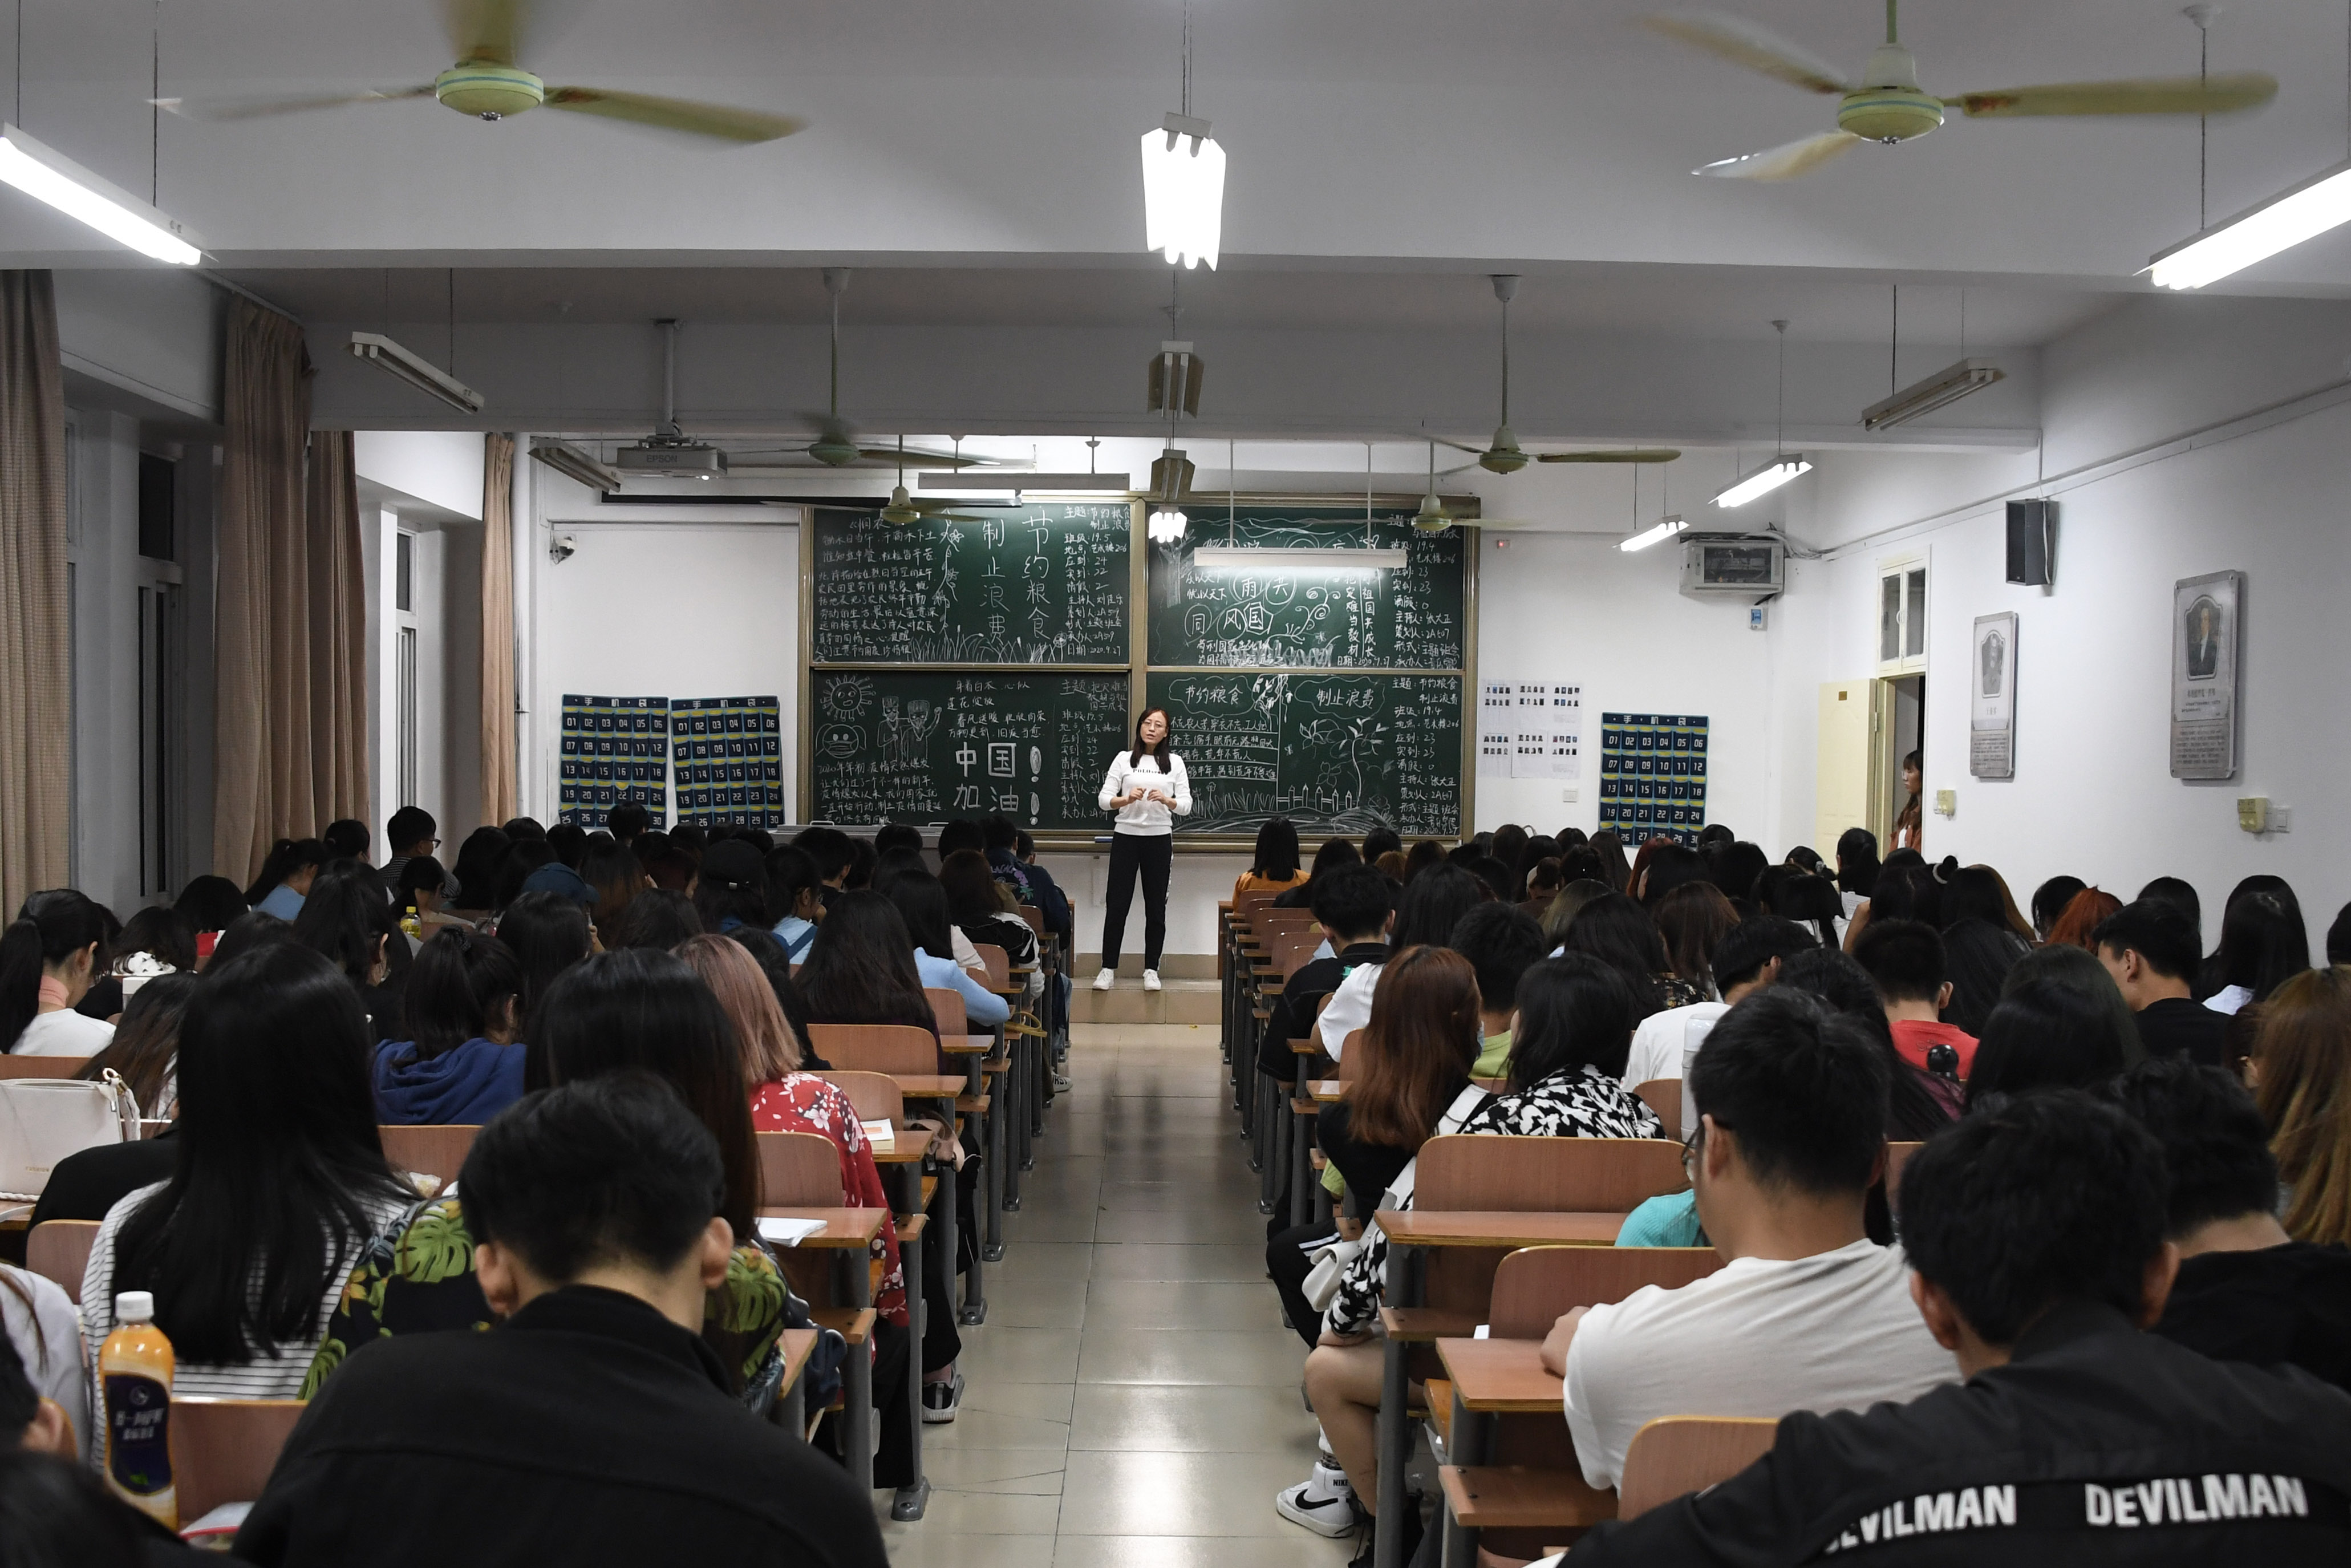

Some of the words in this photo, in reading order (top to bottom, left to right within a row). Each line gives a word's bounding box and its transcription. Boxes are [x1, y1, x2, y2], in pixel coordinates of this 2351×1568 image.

[979, 518, 1011, 646] 制止浪费
[1022, 509, 1053, 640] 节约粮食
[1241, 577, 1256, 598] 雨
[1273, 575, 1288, 597] 共
[1191, 613, 1205, 634] 同
[1223, 608, 1242, 630] 风
[1249, 606, 1264, 630] 国
[1185, 684, 1243, 705] 节约粮食
[1316, 687, 1375, 709] 制止浪费
[767, 719, 775, 728] 06
[767, 742, 775, 750] 12
[1695, 763, 1703, 771] 12
[562, 815, 571, 824] 25
[1673, 834, 1682, 843] 29
[2085, 1473, 2309, 1528] DEVILMAN
